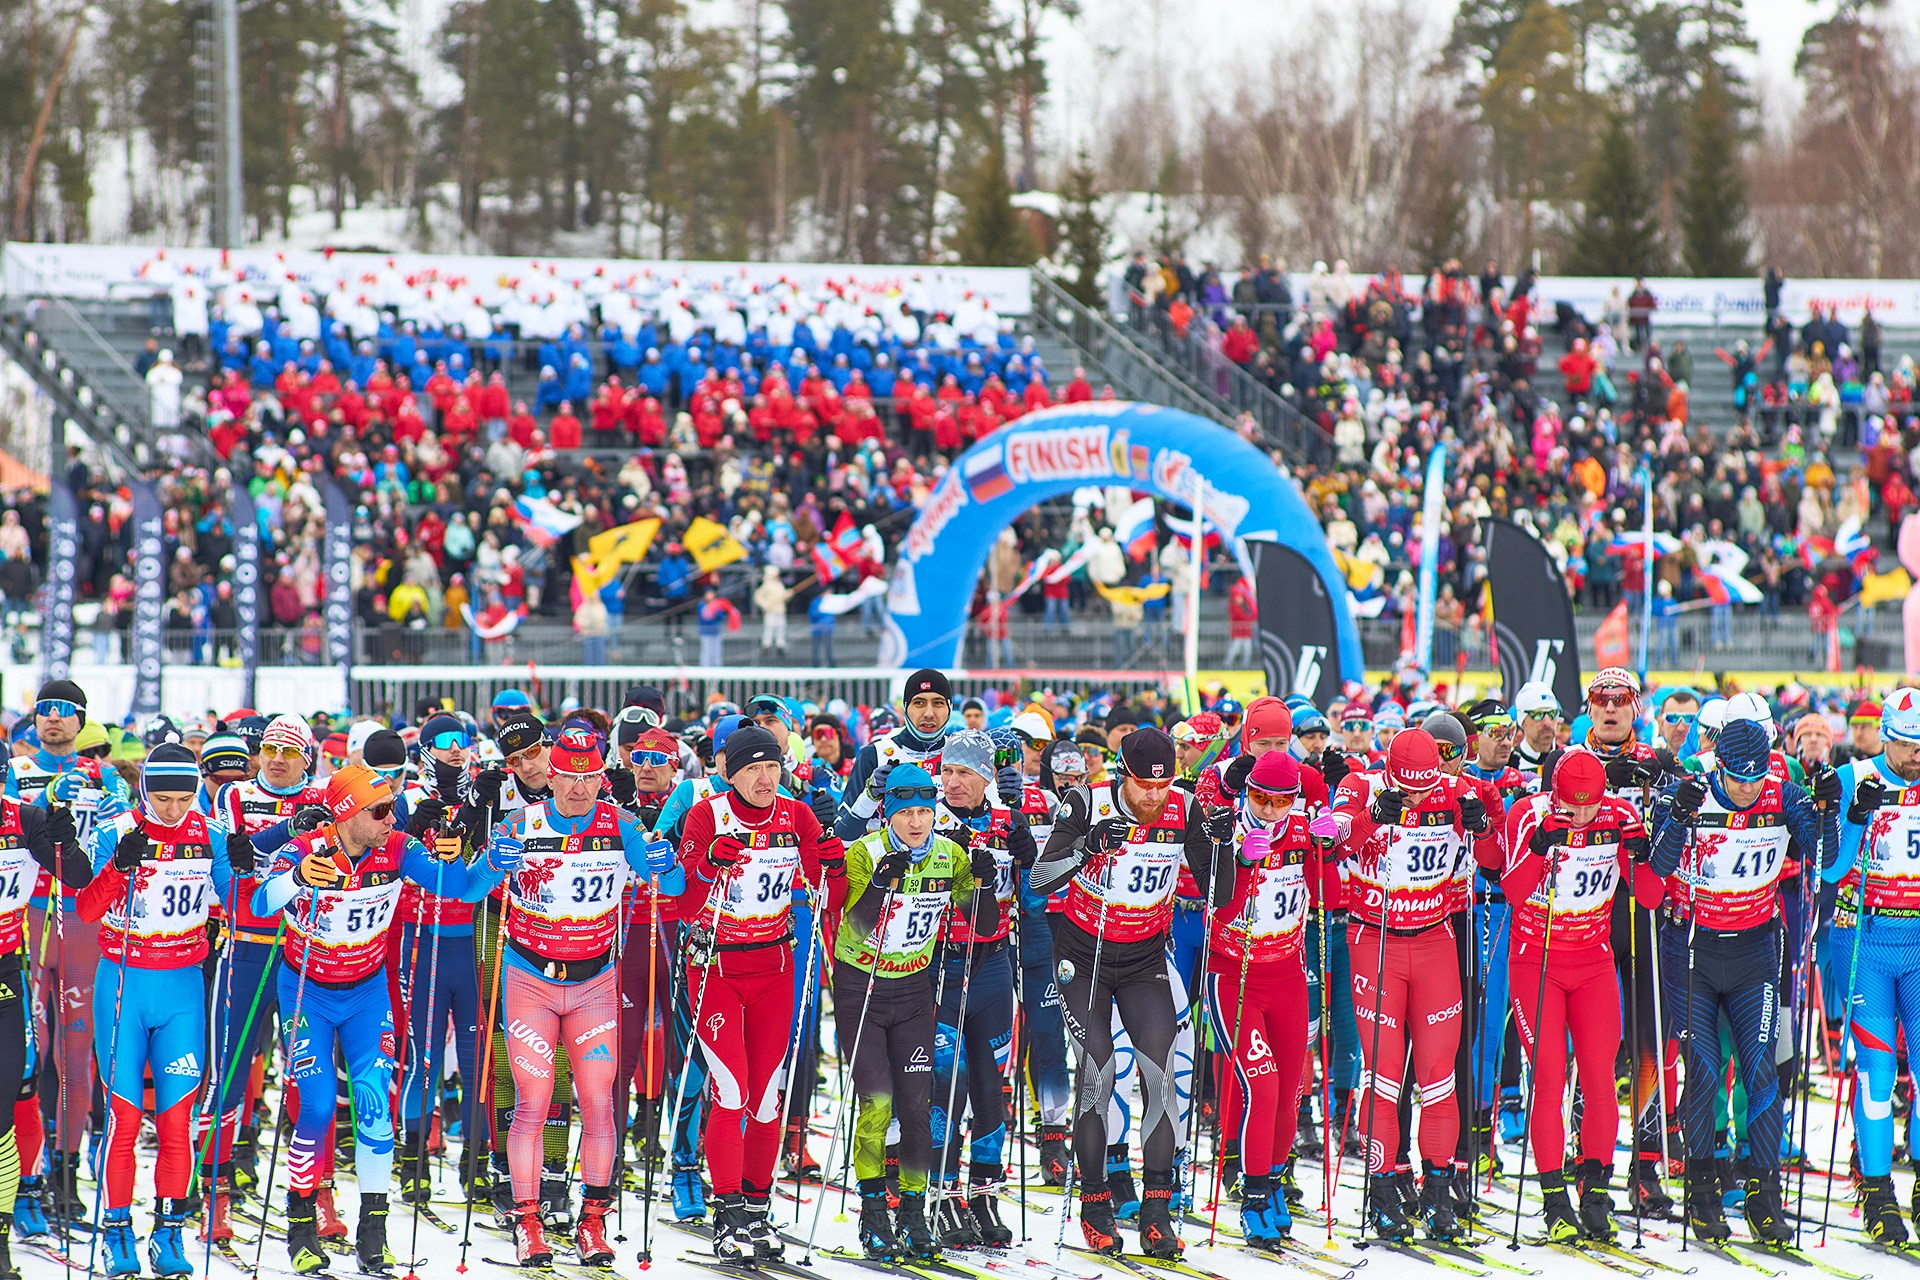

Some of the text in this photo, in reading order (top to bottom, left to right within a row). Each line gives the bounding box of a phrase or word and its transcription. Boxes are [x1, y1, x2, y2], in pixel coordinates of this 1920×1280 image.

[1009, 437, 1105, 478] FINISH
[500, 722, 529, 741] LUKOIL
[923, 763, 933, 772] 50
[1907, 788, 1917, 797] 50
[283, 803, 293, 811] 50
[1407, 812, 1418, 820] 50
[1735, 814, 1746, 822] 50
[1136, 827, 1147, 836] 50
[1407, 830, 1428, 838] Rostec
[1573, 833, 1584, 842] 50
[570, 838, 581, 847] 50
[757, 833, 768, 843] 50
[163, 845, 174, 854] 50
[1134, 851, 1155, 859] Rostec
[1272, 853, 1281, 862] 50
[1406, 842, 1448, 873] 302
[1731, 847, 1777, 878] 419
[911, 878, 919, 888] 50
[1127, 866, 1172, 894] 350
[1573, 864, 1613, 898] 396
[571, 875, 614, 903] 321
[162, 884, 206, 919] 384
[1364, 889, 1444, 914] Демино
[856, 952, 930, 974] Демино
[1058, 993, 1081, 1030] CRAFT
[1355, 1004, 1398, 1029] LUKOIL
[1758, 981, 1774, 1044] O.GRIBKOV
[507, 1018, 555, 1066] LUKOIL
[164, 1065, 201, 1078] adidas
[294, 1066, 324, 1081] MOAX
[904, 1064, 933, 1074] Löffler
[942, 1249, 969, 1261] ADSHUS
